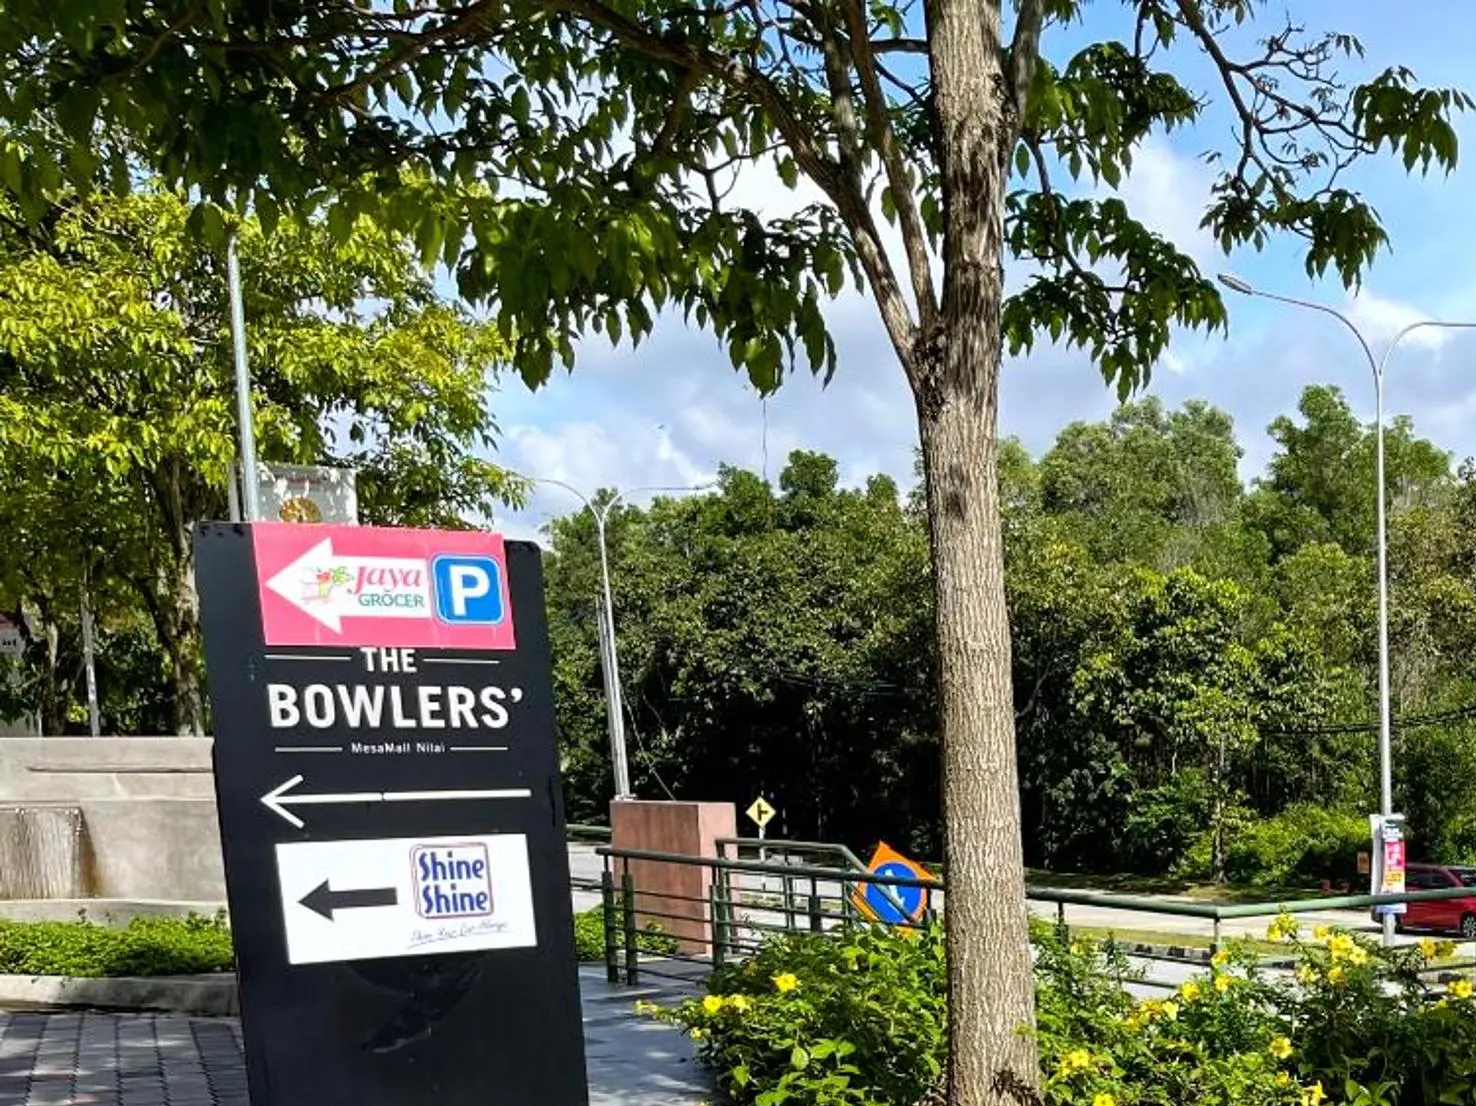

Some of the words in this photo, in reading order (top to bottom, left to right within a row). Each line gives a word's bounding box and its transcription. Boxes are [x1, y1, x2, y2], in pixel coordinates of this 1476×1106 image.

[347, 565, 422, 595] Jaya
[450, 564, 490, 617] P
[357, 592, 426, 608] GROCER
[360, 646, 418, 673] THE
[267, 683, 523, 729] BOWLERS'
[351, 741, 411, 755] MesaMall
[416, 741, 446, 754] Nilai
[418, 850, 485, 882] Shine
[422, 883, 489, 914] Shine
